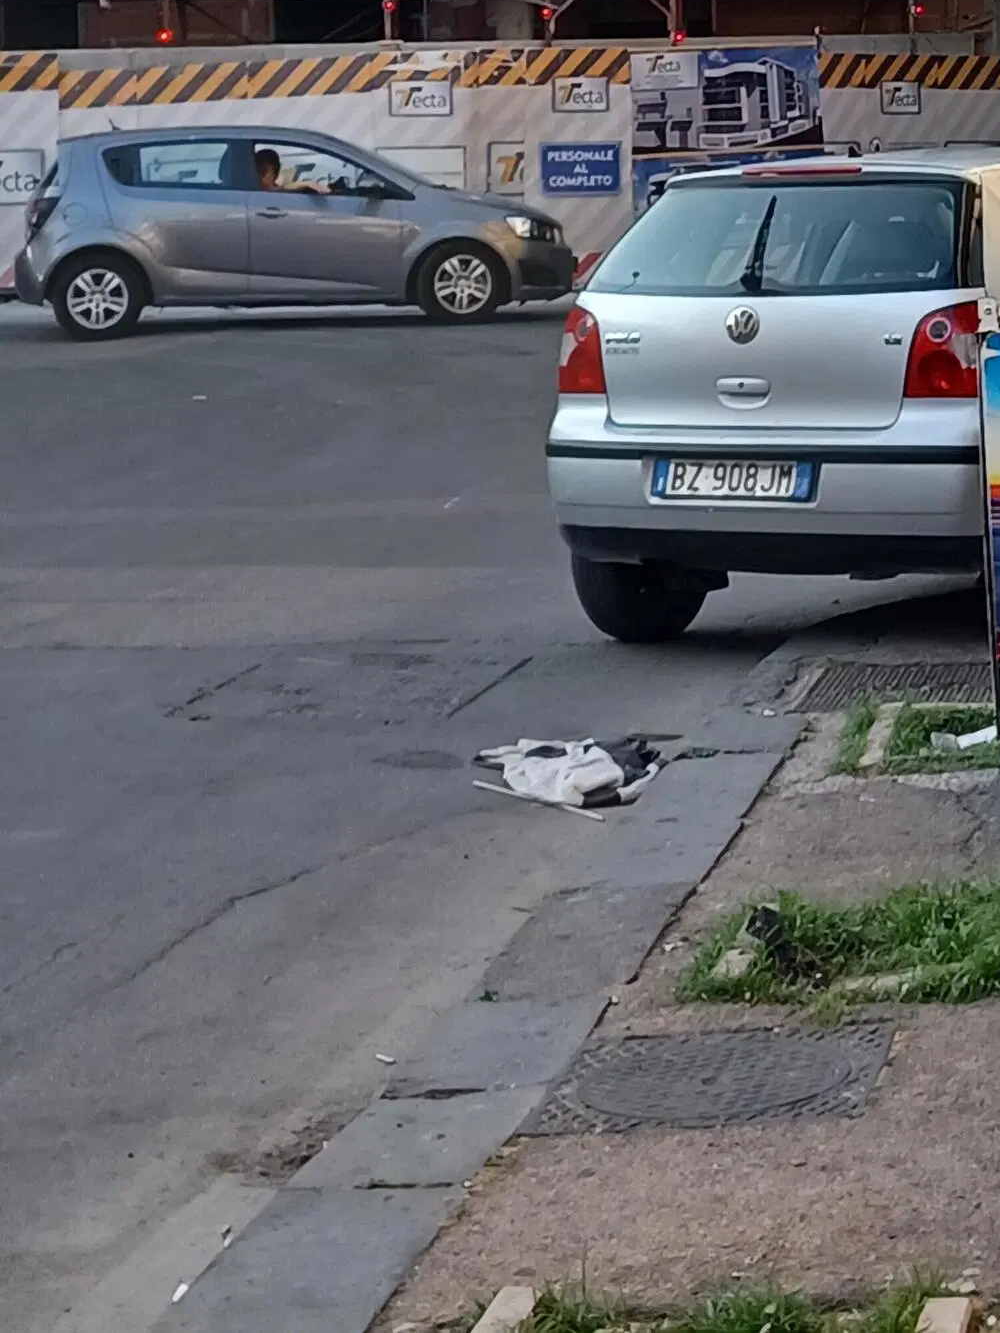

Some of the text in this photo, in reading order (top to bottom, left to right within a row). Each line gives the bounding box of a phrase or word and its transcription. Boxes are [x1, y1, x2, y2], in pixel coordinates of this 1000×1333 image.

[395, 87, 447, 109] Tecta
[559, 83, 604, 105] Tecta
[547, 150, 614, 162] PERSONALE
[573, 163, 589, 174] AL
[549, 175, 613, 187] COMPLETO
[671, 462, 704, 492] BZ
